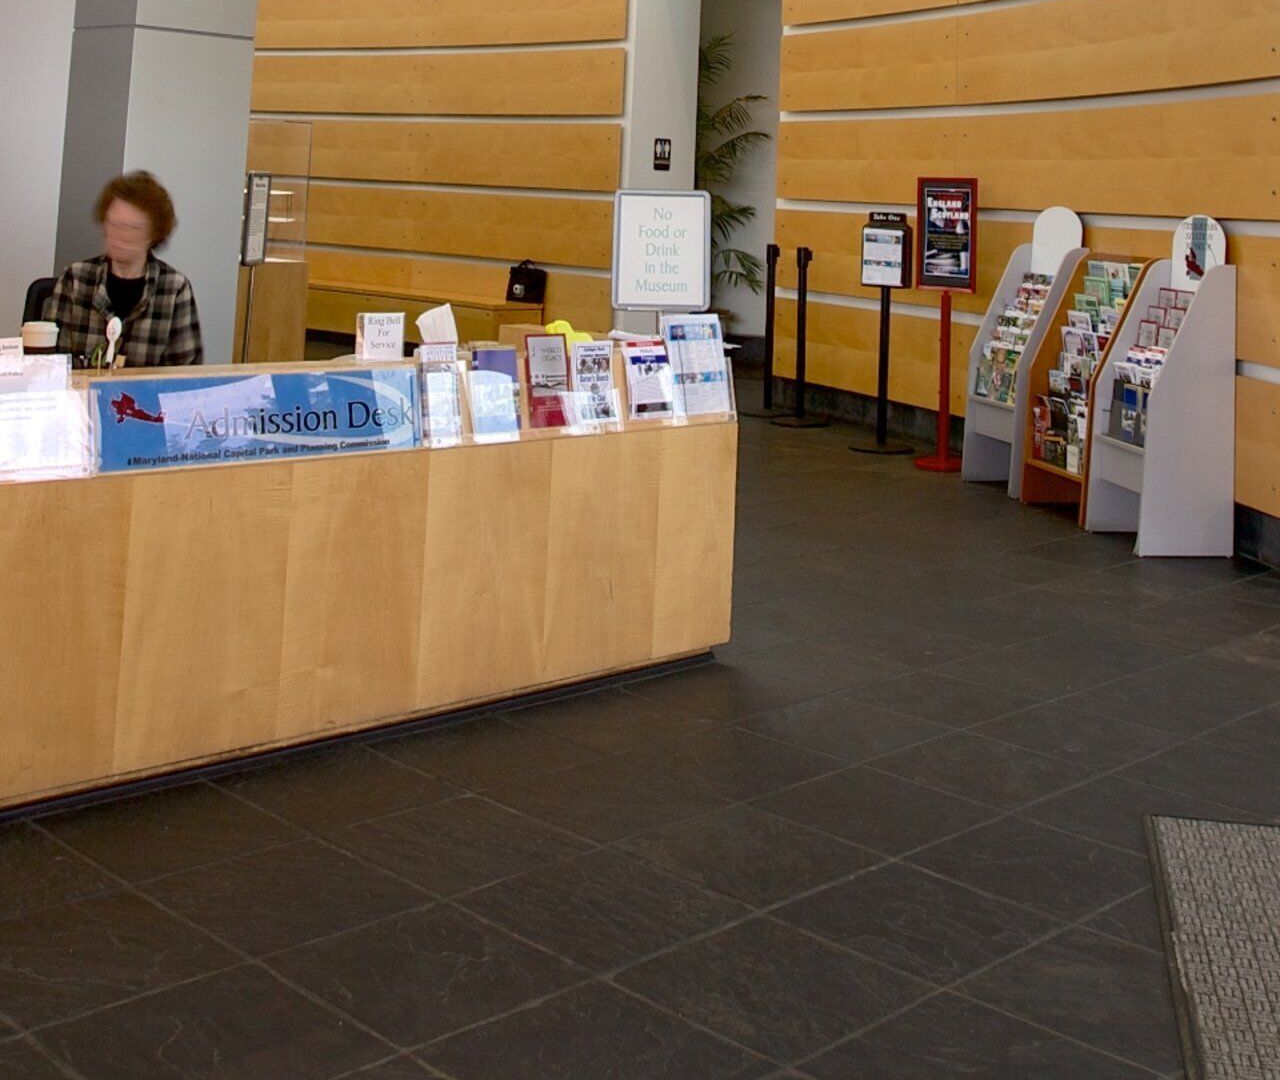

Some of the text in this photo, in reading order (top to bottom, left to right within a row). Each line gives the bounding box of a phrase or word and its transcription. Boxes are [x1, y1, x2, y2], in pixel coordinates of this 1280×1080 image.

[654, 207, 673, 221] No
[872, 213, 901, 222] Take One
[639, 224, 688, 239] Food or
[645, 242, 680, 257] Drink
[660, 260, 680, 275] the
[635, 278, 689, 293] Museum
[367, 316, 401, 327] Ring Bell
[377, 329, 390, 337] For
[369, 341, 397, 350] Service
[185, 396, 415, 440] Admission Desk
[132, 437, 391, 467] Maryland-National Capital Park and Planning Commission
